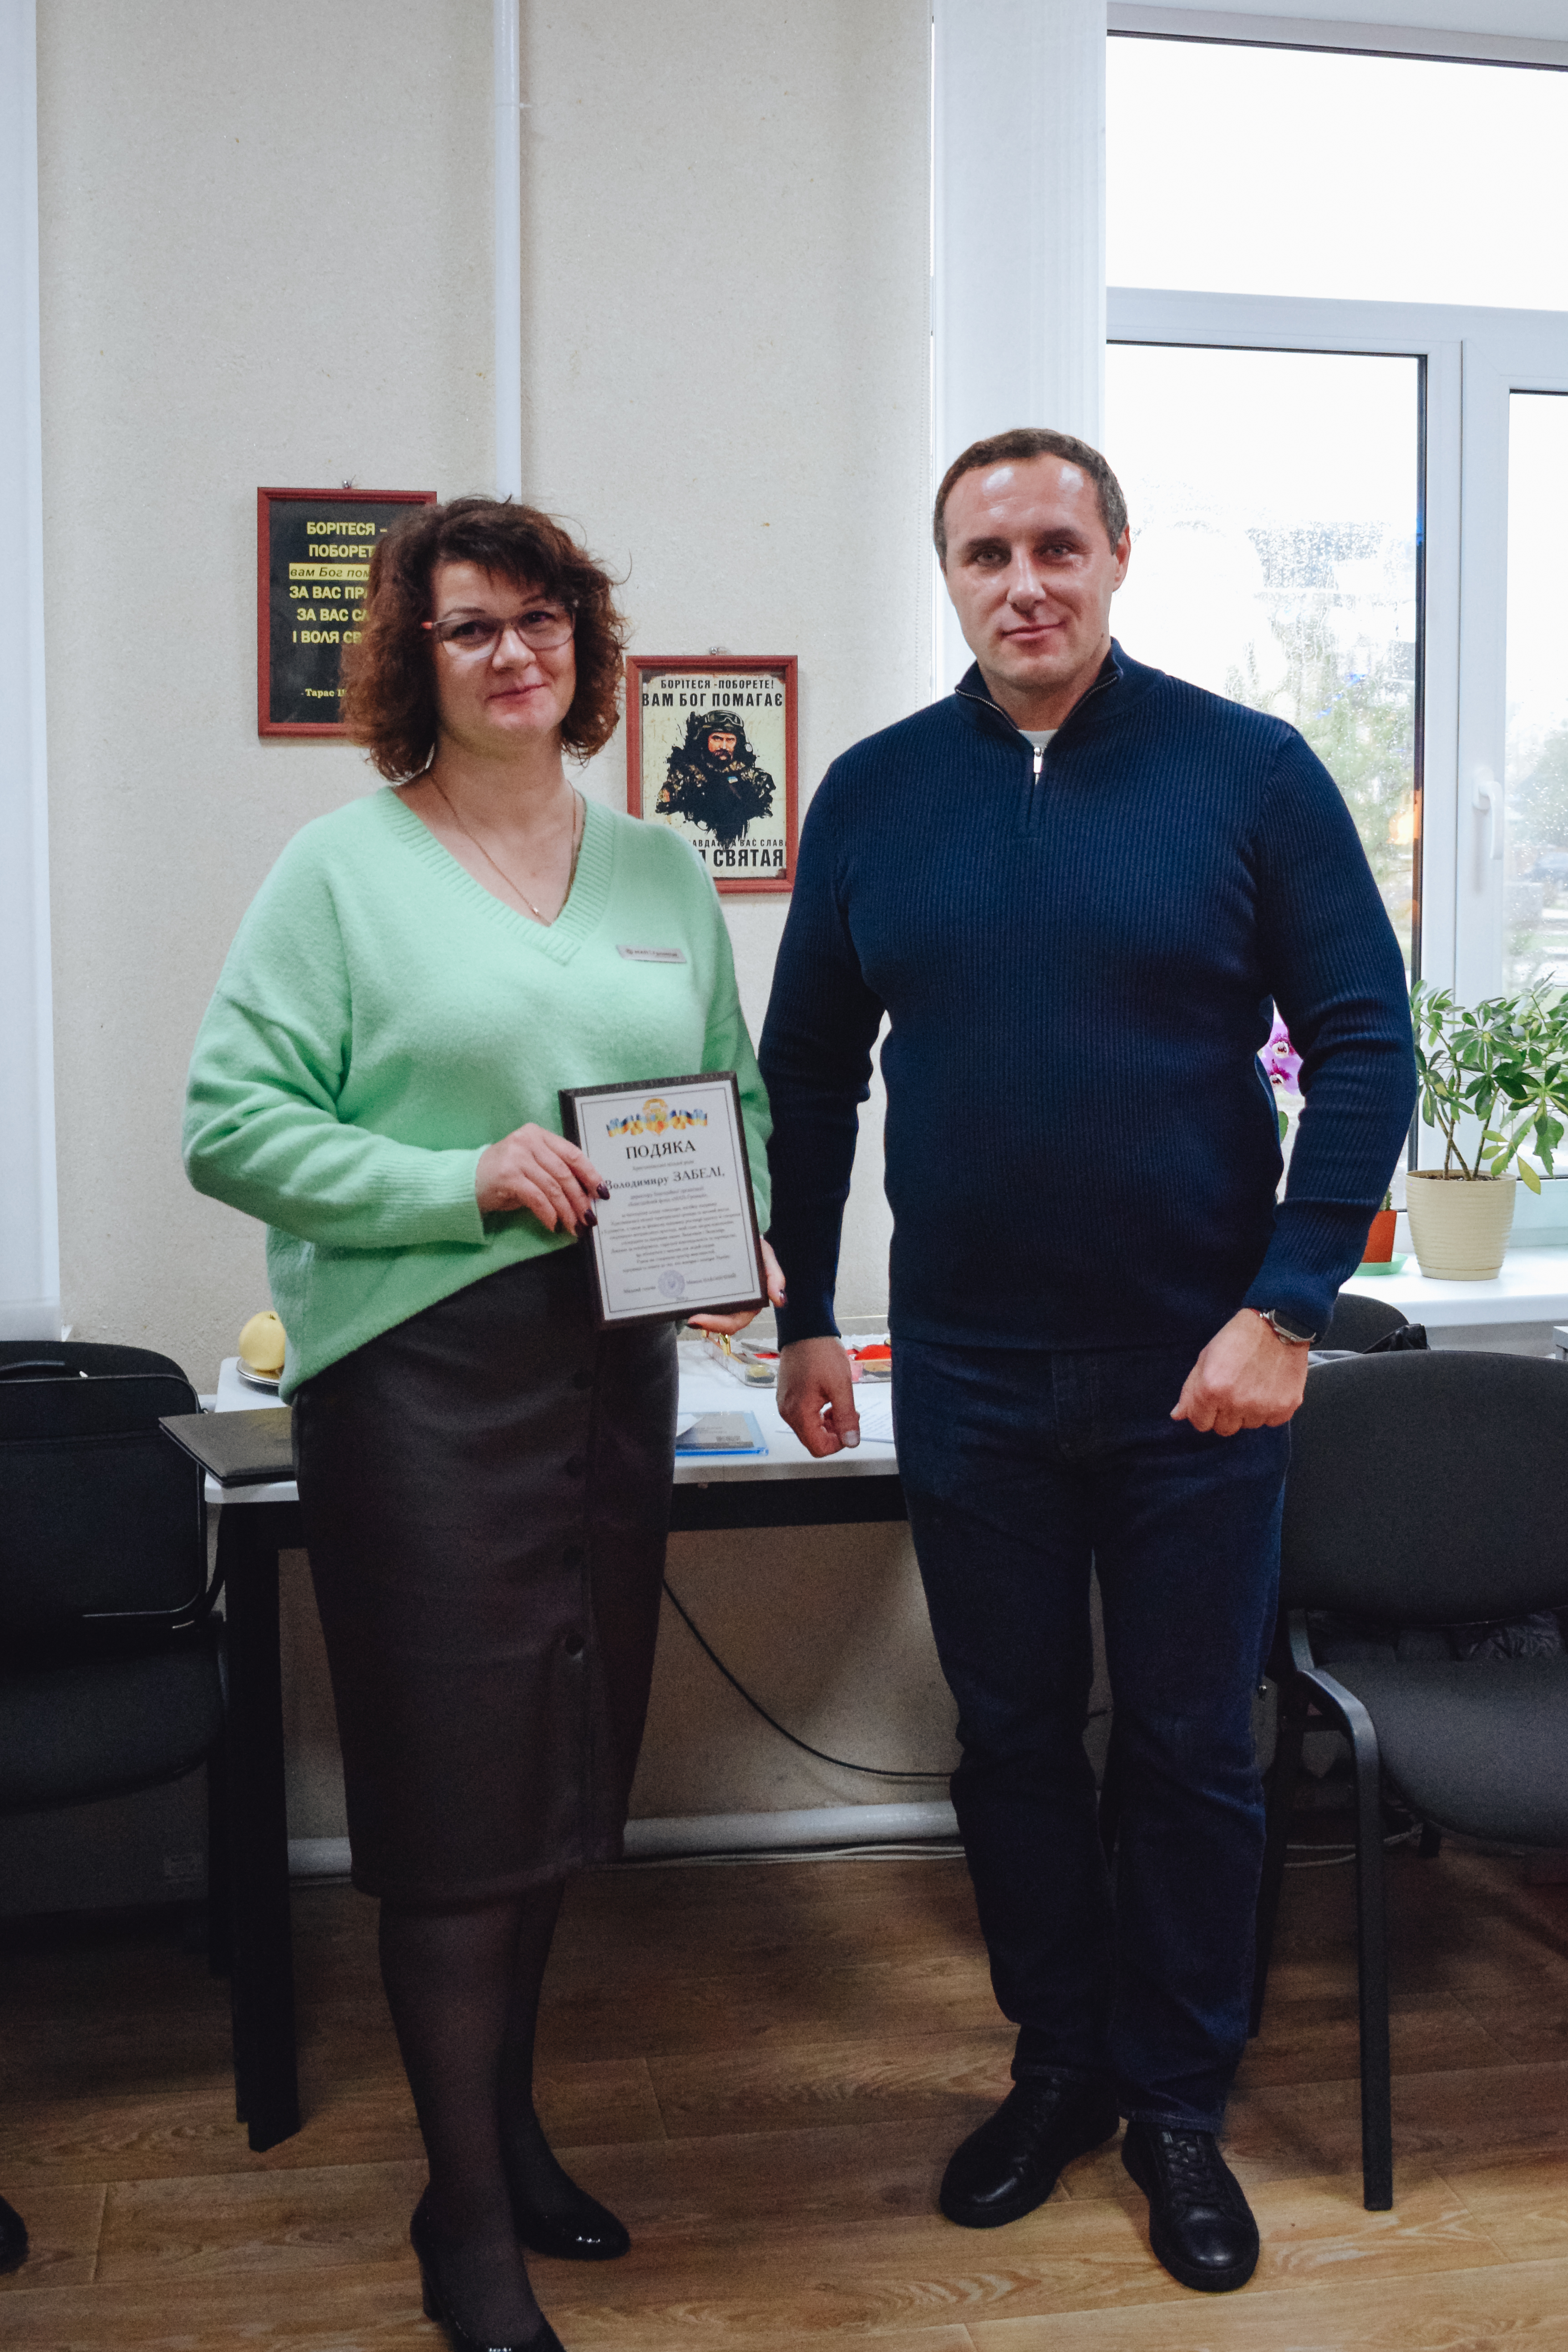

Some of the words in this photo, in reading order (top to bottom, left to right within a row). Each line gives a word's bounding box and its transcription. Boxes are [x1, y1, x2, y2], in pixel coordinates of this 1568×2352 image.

[307, 522, 375, 535] БОРІТЕСЯ
[309, 544, 376, 558] ПОБОРЕТ
[320, 567, 342, 578] Бог
[289, 586, 309, 598] ЗА
[313, 586, 341, 599] ВАС
[297, 608, 316, 621] ЗА
[320, 608, 349, 621] ВАС
[301, 631, 339, 644] ВОЛЯ
[661, 680, 710, 689] БОРІТЕСЯ
[305, 688, 335, 698] Тарас
[642, 693, 673, 706] ВАМ
[680, 693, 706, 706] БОГ
[712, 693, 782, 706] ПОМАГАЄ
[714, 849, 783, 867] СВЯТАЯ
[626, 1140, 696, 1159] ПОДЯКА
[605, 1176, 669, 1190] Володимиру
